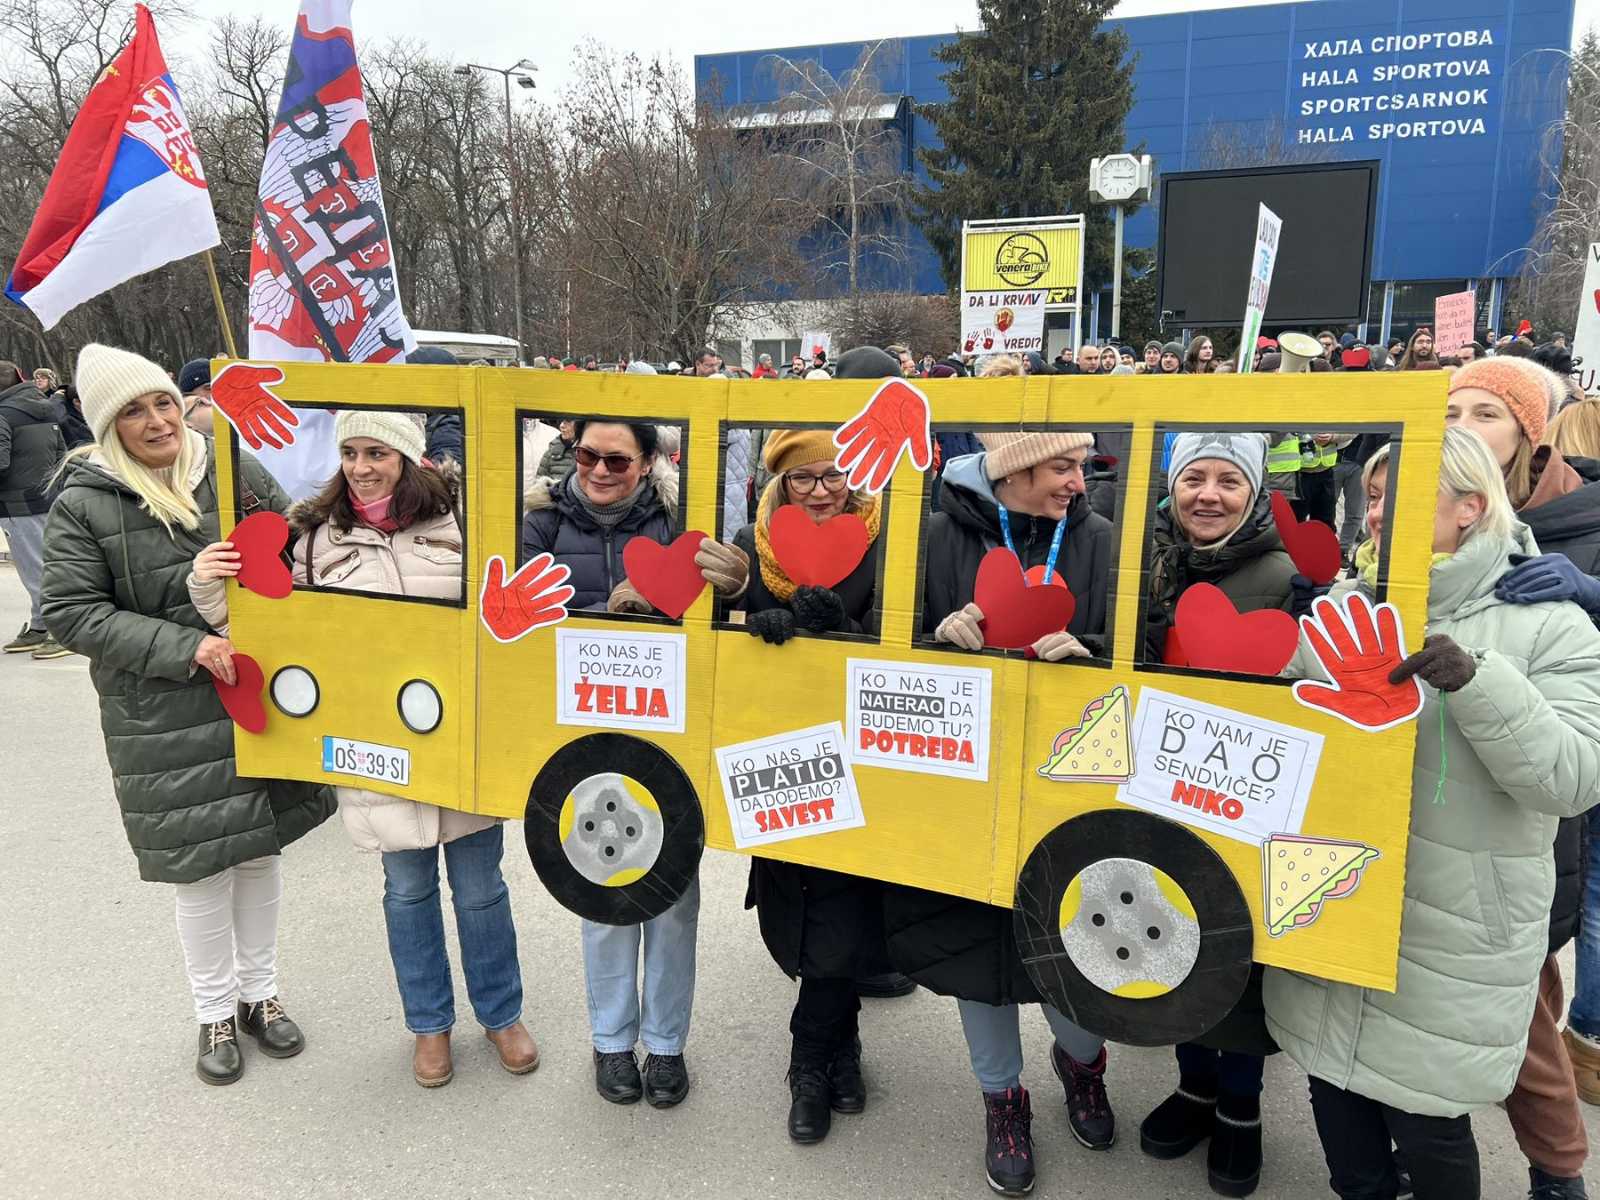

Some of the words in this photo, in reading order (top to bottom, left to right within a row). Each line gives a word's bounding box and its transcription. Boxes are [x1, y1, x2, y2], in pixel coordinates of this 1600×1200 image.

[1304, 39, 1363, 58] ХАЛА
[1371, 29, 1493, 53] СПОРТОВА
[1301, 68, 1359, 88] HALA
[1373, 59, 1491, 82] SPORTOVA
[1301, 88, 1488, 115] SPORTCSARNOK
[1298, 127, 1354, 144] HALA
[1368, 118, 1486, 139] SPORTOVA
[969, 295, 985, 308] DA
[989, 294, 999, 307] LI
[1004, 337, 1041, 350] VREDI?
[579, 643, 601, 657] KO
[607, 645, 638, 660] NAS
[644, 647, 662, 661] JE
[579, 661, 662, 680] DOVEZAO?
[861, 672, 886, 689] KO
[900, 676, 937, 694] NAS
[951, 681, 973, 697] JE
[574, 675, 669, 718] ŽELJA
[861, 691, 943, 716] NATERAO
[950, 701, 974, 718] DA
[861, 712, 934, 734] BUDEMO
[939, 721, 972, 738] TU?
[1164, 708, 1196, 731] KO
[1204, 719, 1253, 748] NAM
[1260, 737, 1288, 758] JE
[335, 742, 357, 771] OŠ
[731, 758, 755, 775] KO
[766, 747, 801, 768] NAS
[813, 740, 834, 758] JE
[860, 727, 975, 764] POTREBA
[1160, 725, 1281, 783] DAO
[735, 757, 838, 797] PLATIO
[1153, 754, 1276, 805] SENDVIČE?
[740, 798, 763, 813] DA
[1171, 779, 1244, 821] NIKO
[754, 797, 835, 833] SAVEST
